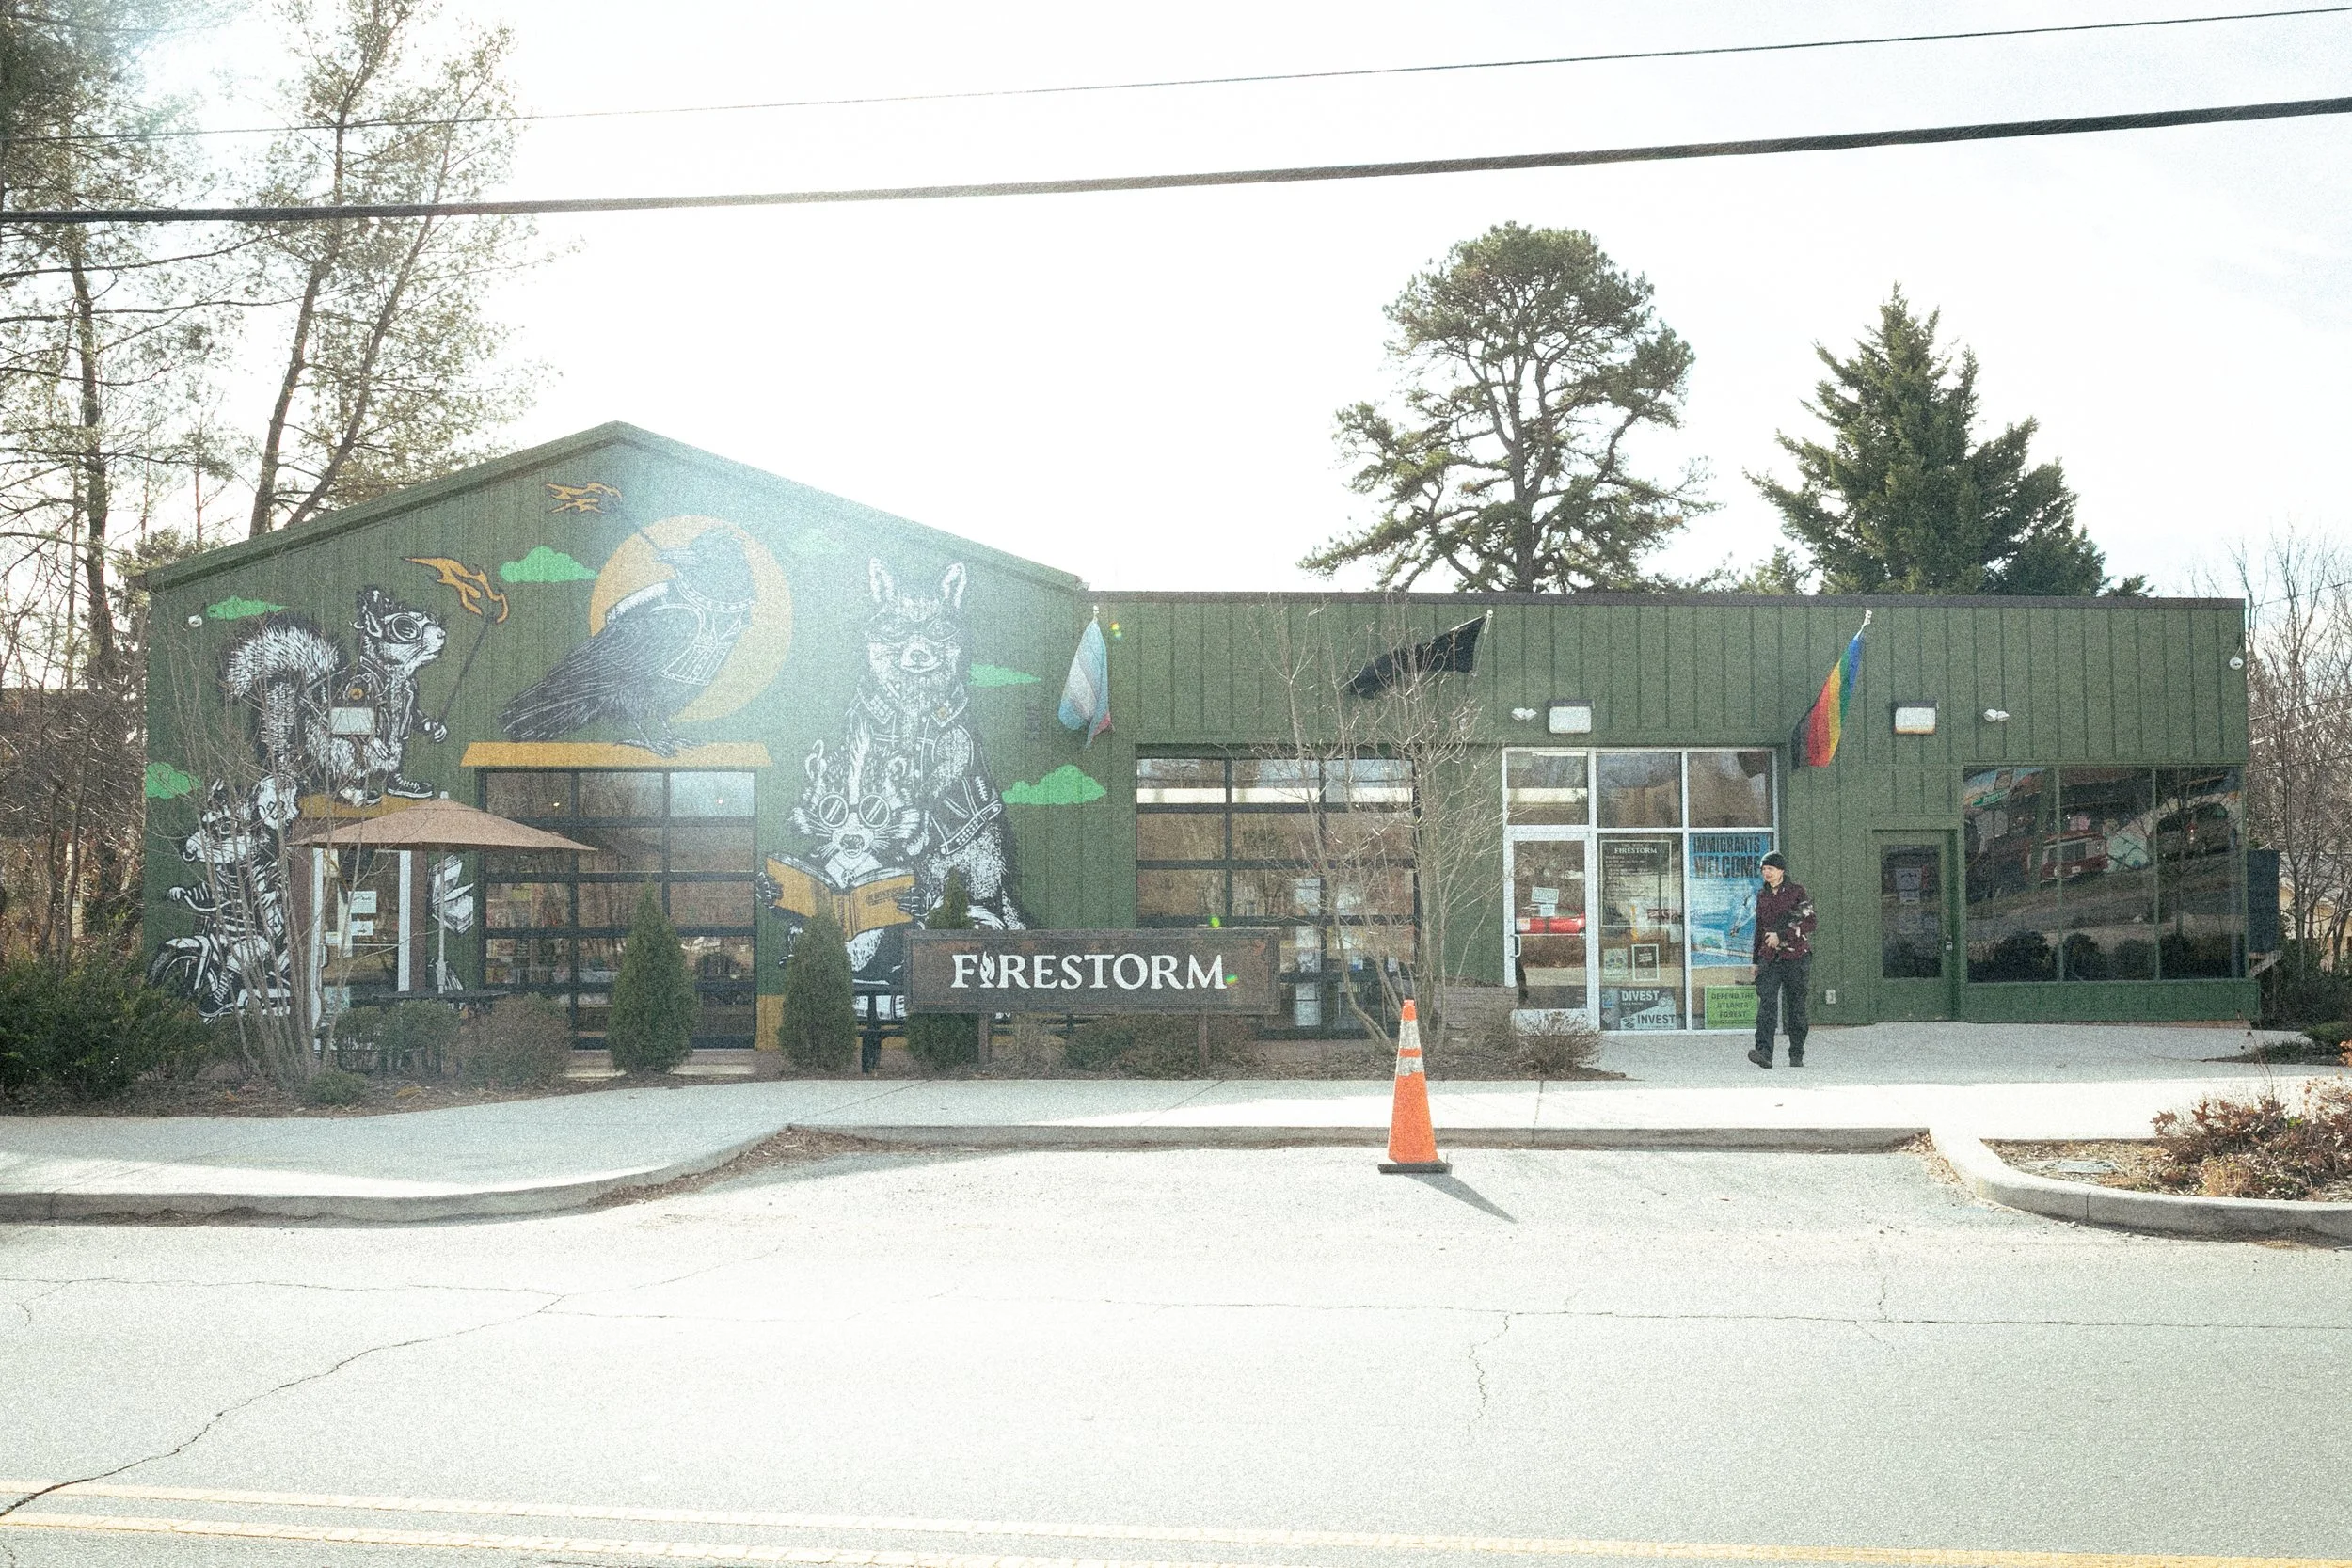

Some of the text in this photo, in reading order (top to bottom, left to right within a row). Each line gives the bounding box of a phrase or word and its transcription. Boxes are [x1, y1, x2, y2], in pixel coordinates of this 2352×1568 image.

[1694, 836, 1760, 853] IMMIGRANTS
[1694, 855, 1761, 879] WELCOME
[950, 951, 1227, 990] FIRESTORM
[1621, 990, 1660, 1001] DIVEST
[1637, 1014, 1676, 1024] INVEST
